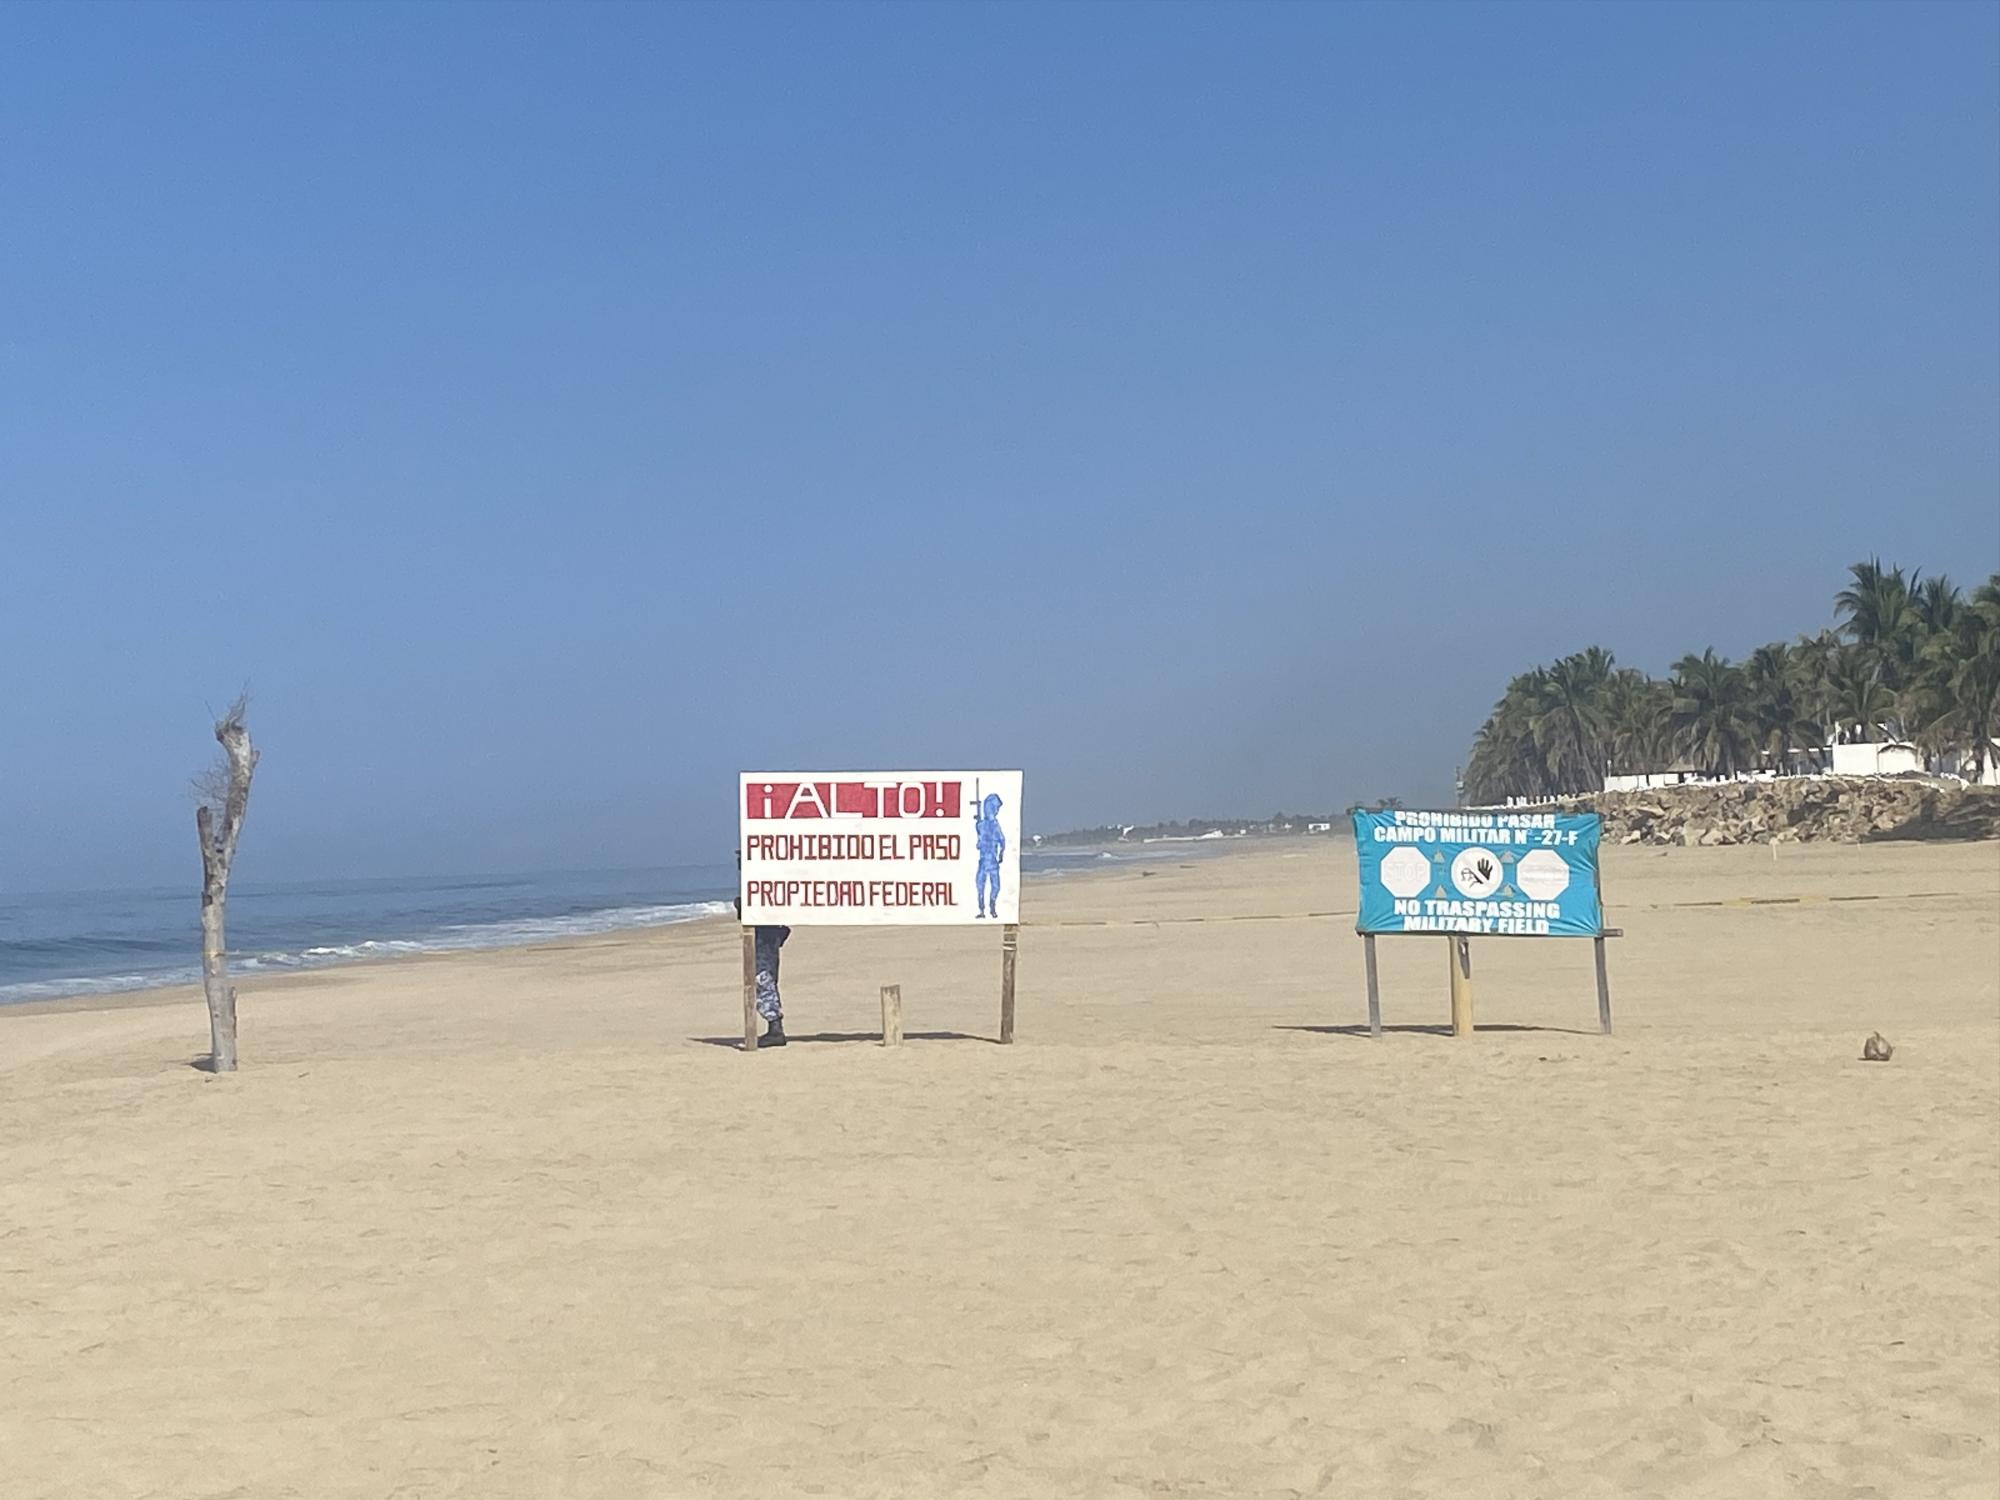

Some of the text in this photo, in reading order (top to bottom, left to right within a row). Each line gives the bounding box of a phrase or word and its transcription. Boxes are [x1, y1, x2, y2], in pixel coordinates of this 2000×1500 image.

[762, 782, 945, 818] ¡ALTO!
[1394, 811, 1555, 829] PROHIBIDO PASAR
[1375, 826, 1436, 843] CAMPO
[1440, 828, 1510, 844] MILITAR
[747, 835, 960, 860] PROHIBIDO EL PASO
[747, 881, 958, 907] PROPIEDAD FEDERAL
[1394, 899, 1560, 919] NO TRASPASSING
[1403, 916, 1550, 934] MILITARY FIELD
